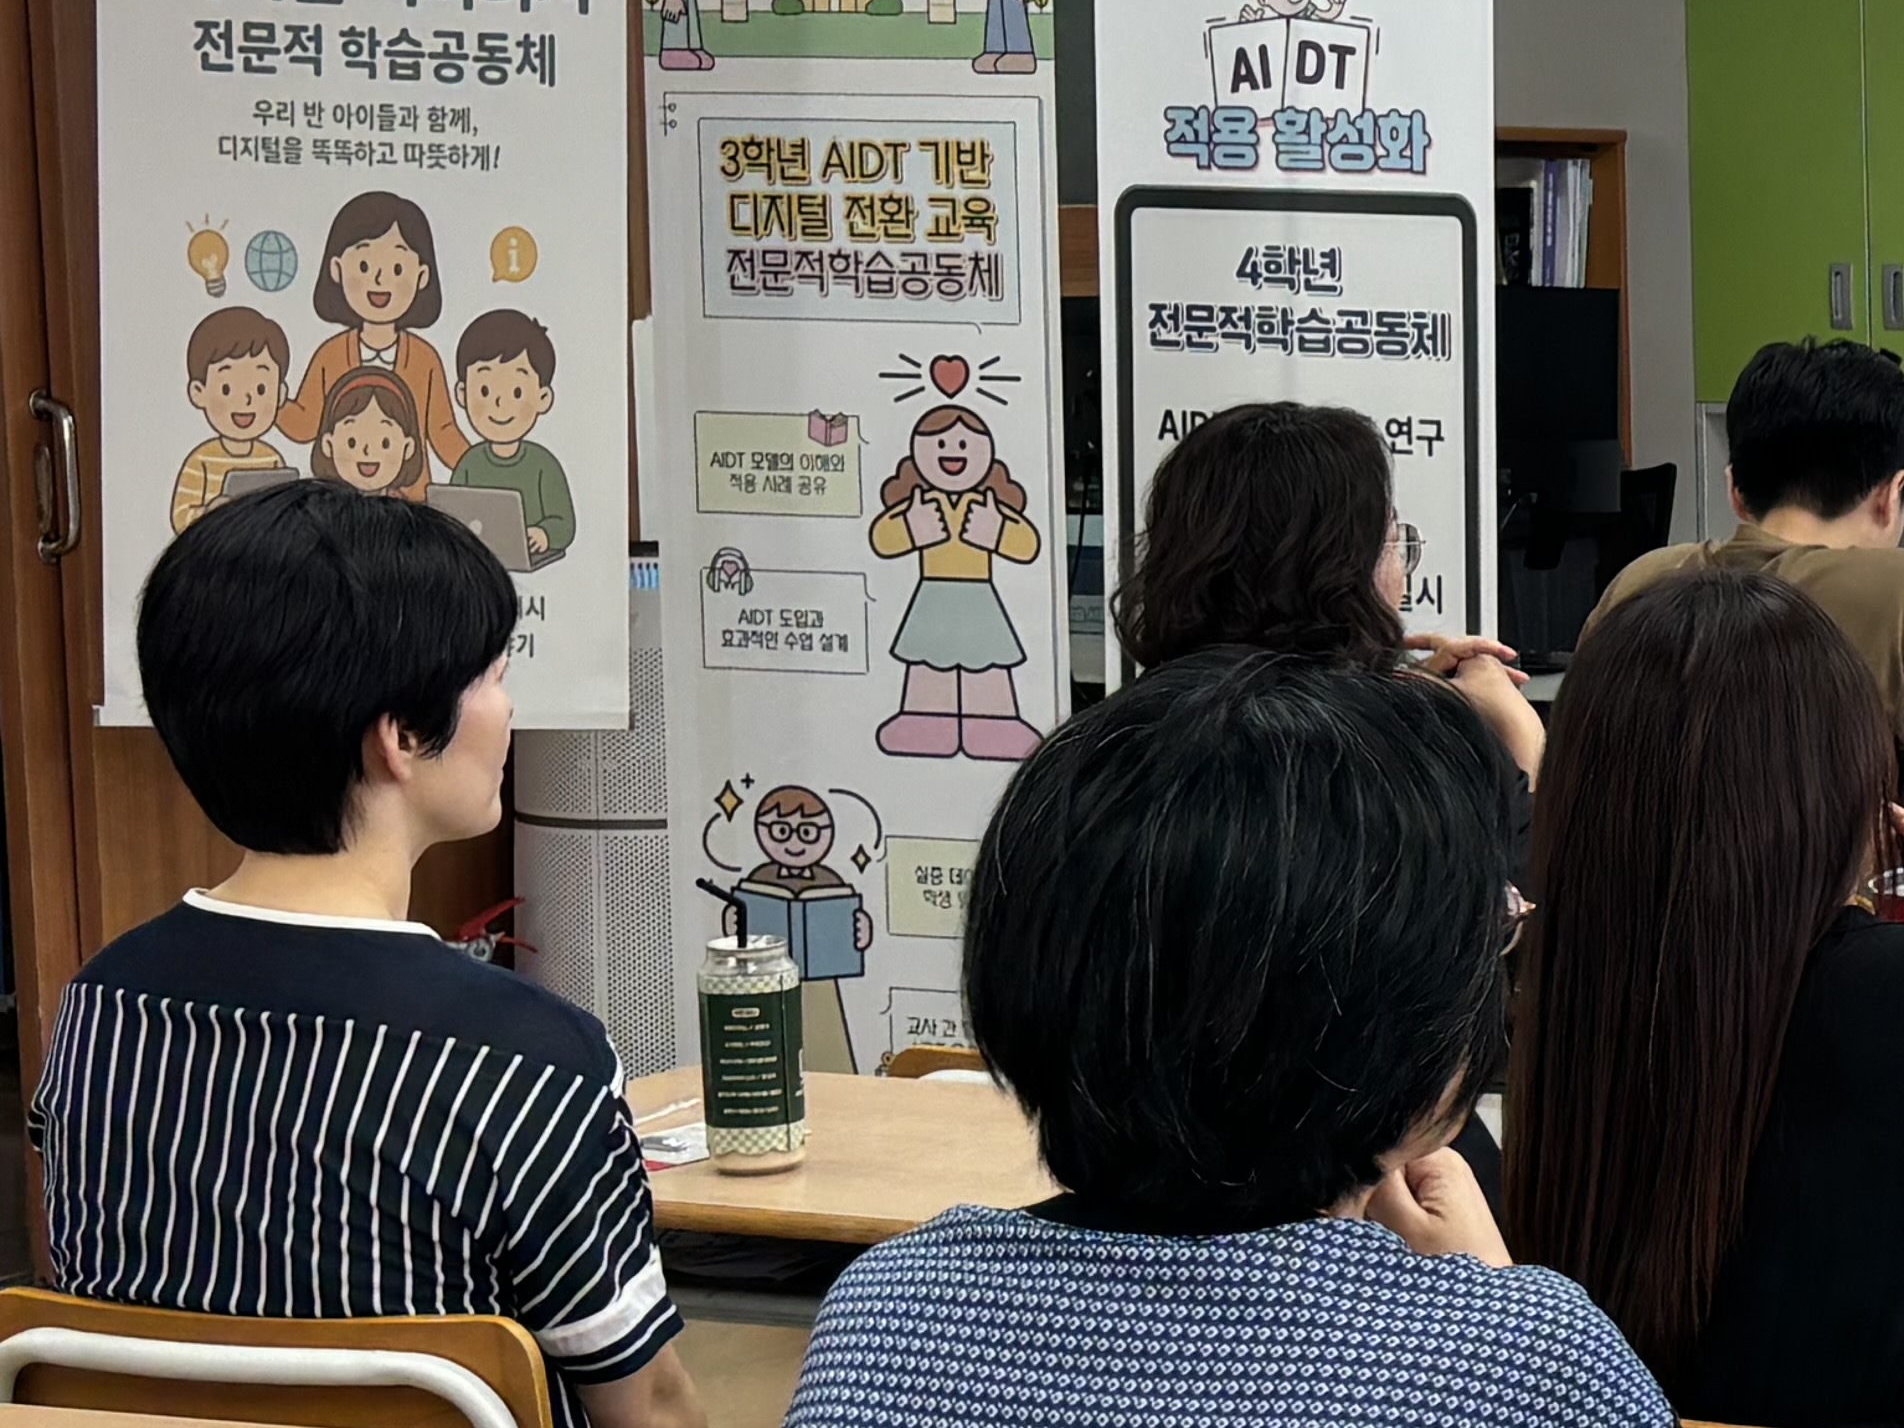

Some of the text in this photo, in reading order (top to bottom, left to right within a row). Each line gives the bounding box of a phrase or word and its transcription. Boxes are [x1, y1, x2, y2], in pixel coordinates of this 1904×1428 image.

[193, 18, 557, 87] 전문적 학습공동체
[1230, 40, 1356, 93] AI DT
[253, 100, 479, 136] 우리 반 아이들과 함께,
[1163, 105, 1432, 173] 적용 활성화
[218, 136, 501, 172] 디지털을 똑똑하고 따뜻하게!
[720, 136, 992, 187] 3학년 AIDT 기반
[728, 194, 997, 243] 디지털 전환 교육
[726, 249, 1002, 299] 전문적학습공동체
[1235, 245, 1343, 295] 4학년
[1149, 302, 1452, 361] 전문적학습공동체
[710, 451, 746, 469] AIDT
[730, 473, 827, 496] 적용 사례 공유
[738, 608, 824, 628] AIDT 도입과
[784, 631, 814, 651] 수업
[907, 1016, 937, 1036] 교사
